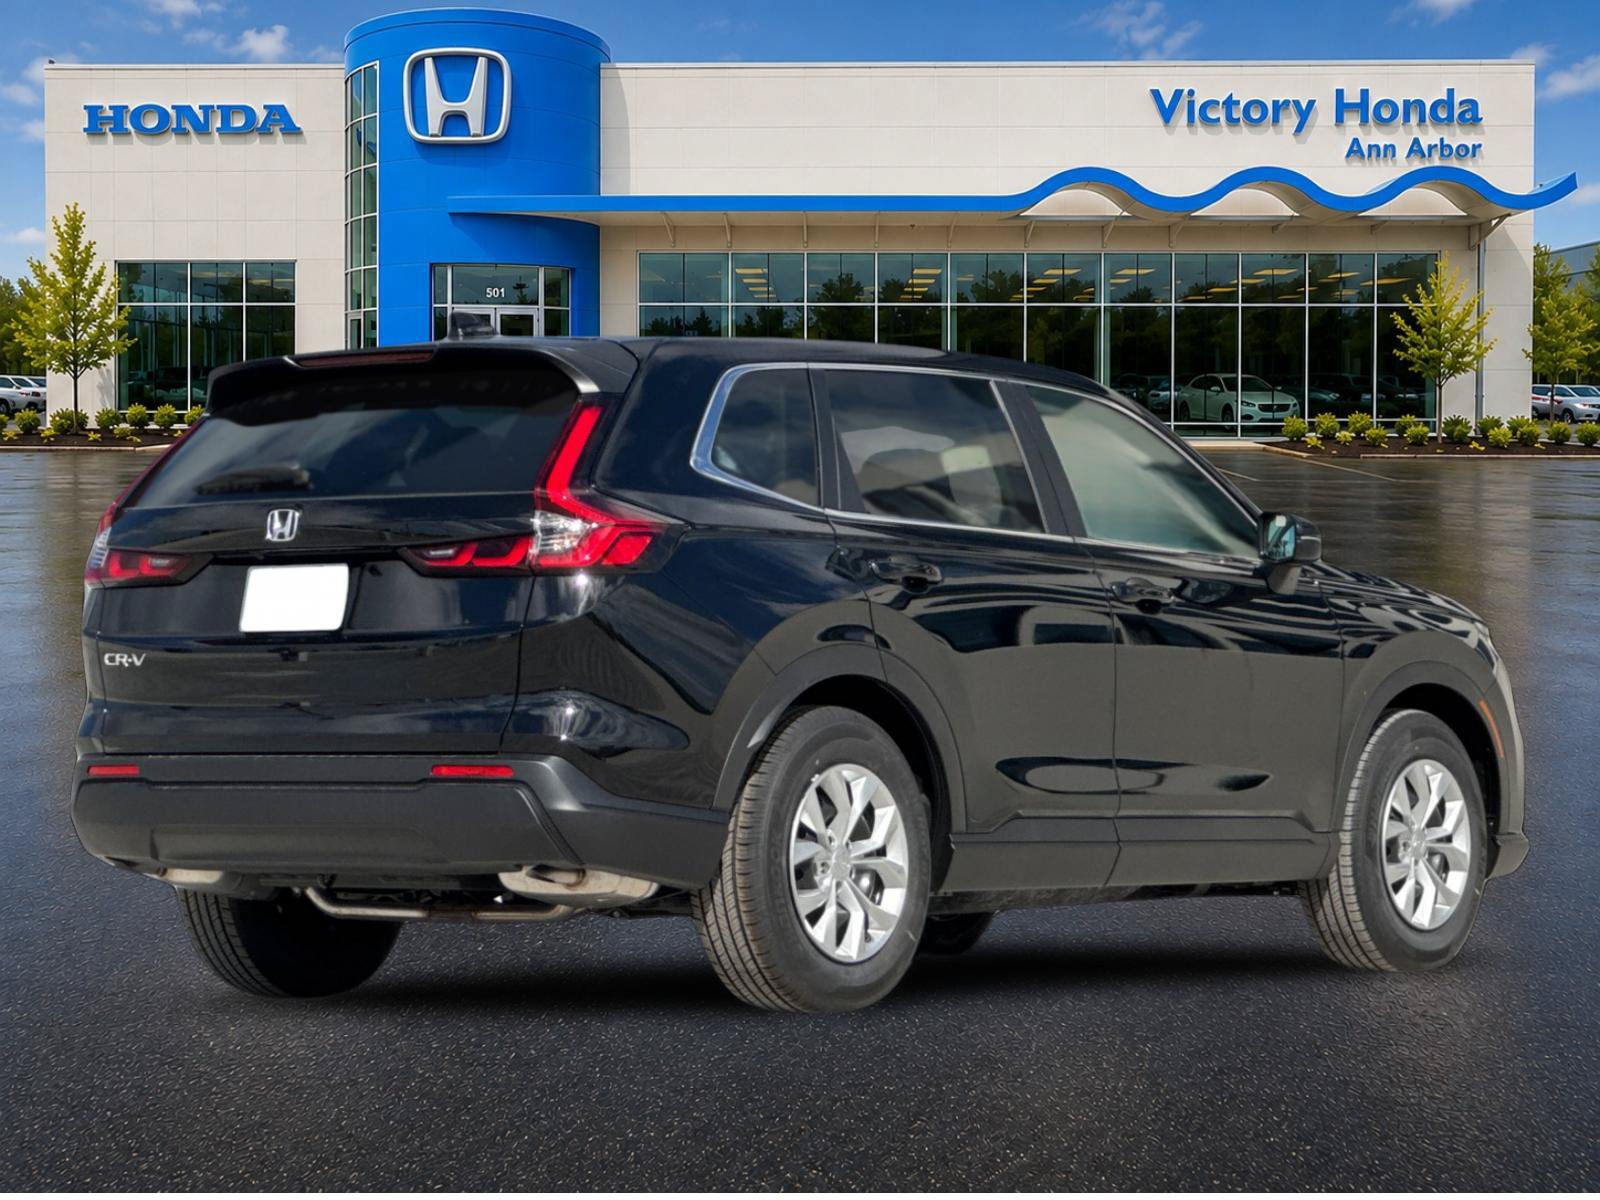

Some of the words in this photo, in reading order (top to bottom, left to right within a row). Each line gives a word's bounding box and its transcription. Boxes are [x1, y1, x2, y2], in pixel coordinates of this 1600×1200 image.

[83, 103, 302, 135] HONDA
[1151, 88, 1316, 135] Victory
[1335, 88, 1483, 125] Honda
[1345, 137, 1397, 159] Ann
[1406, 137, 1482, 159] Arbor
[486, 287, 505, 298] 501
